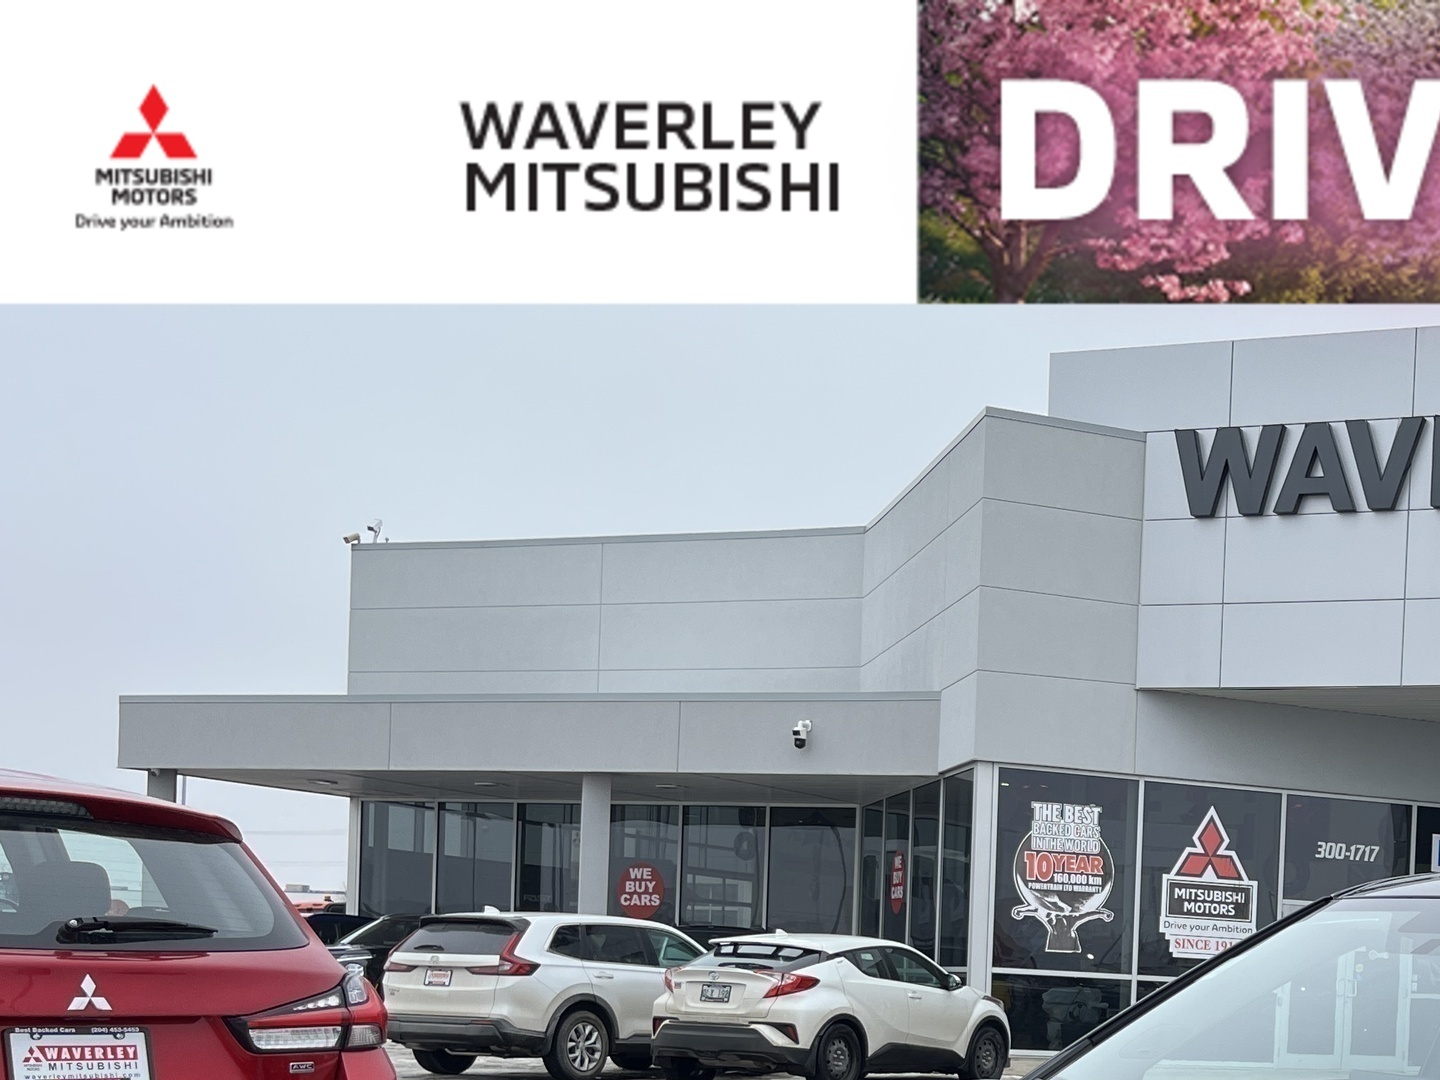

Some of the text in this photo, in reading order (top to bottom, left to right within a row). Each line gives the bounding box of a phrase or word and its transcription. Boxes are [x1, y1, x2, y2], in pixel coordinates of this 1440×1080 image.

[1032, 801, 1102, 825] THE BEST
[1033, 822, 1100, 839] BACKED CARS
[1033, 837, 1100, 852] IN THE WORLD
[1315, 841, 1380, 862] 300-1717
[1024, 851, 1104, 881] 10 YEAR
[629, 868, 652, 880] WE
[1053, 873, 1103, 885] 160,000 km
[625, 881, 656, 893] BUY
[620, 894, 660, 906] CARS
[1174, 887, 1245, 904] MITSUBISHI
[1183, 901, 1236, 915] MOTORS
[1163, 920, 1253, 934] Drive your Ambition
[1174, 937, 1235, 952] SINCE 191
[44, 1046, 136, 1060] WAVERLEY
[48, 1061, 138, 1071] MITSUBISHI
[24, 1072, 141, 1080] waverleymitsubishi.com
